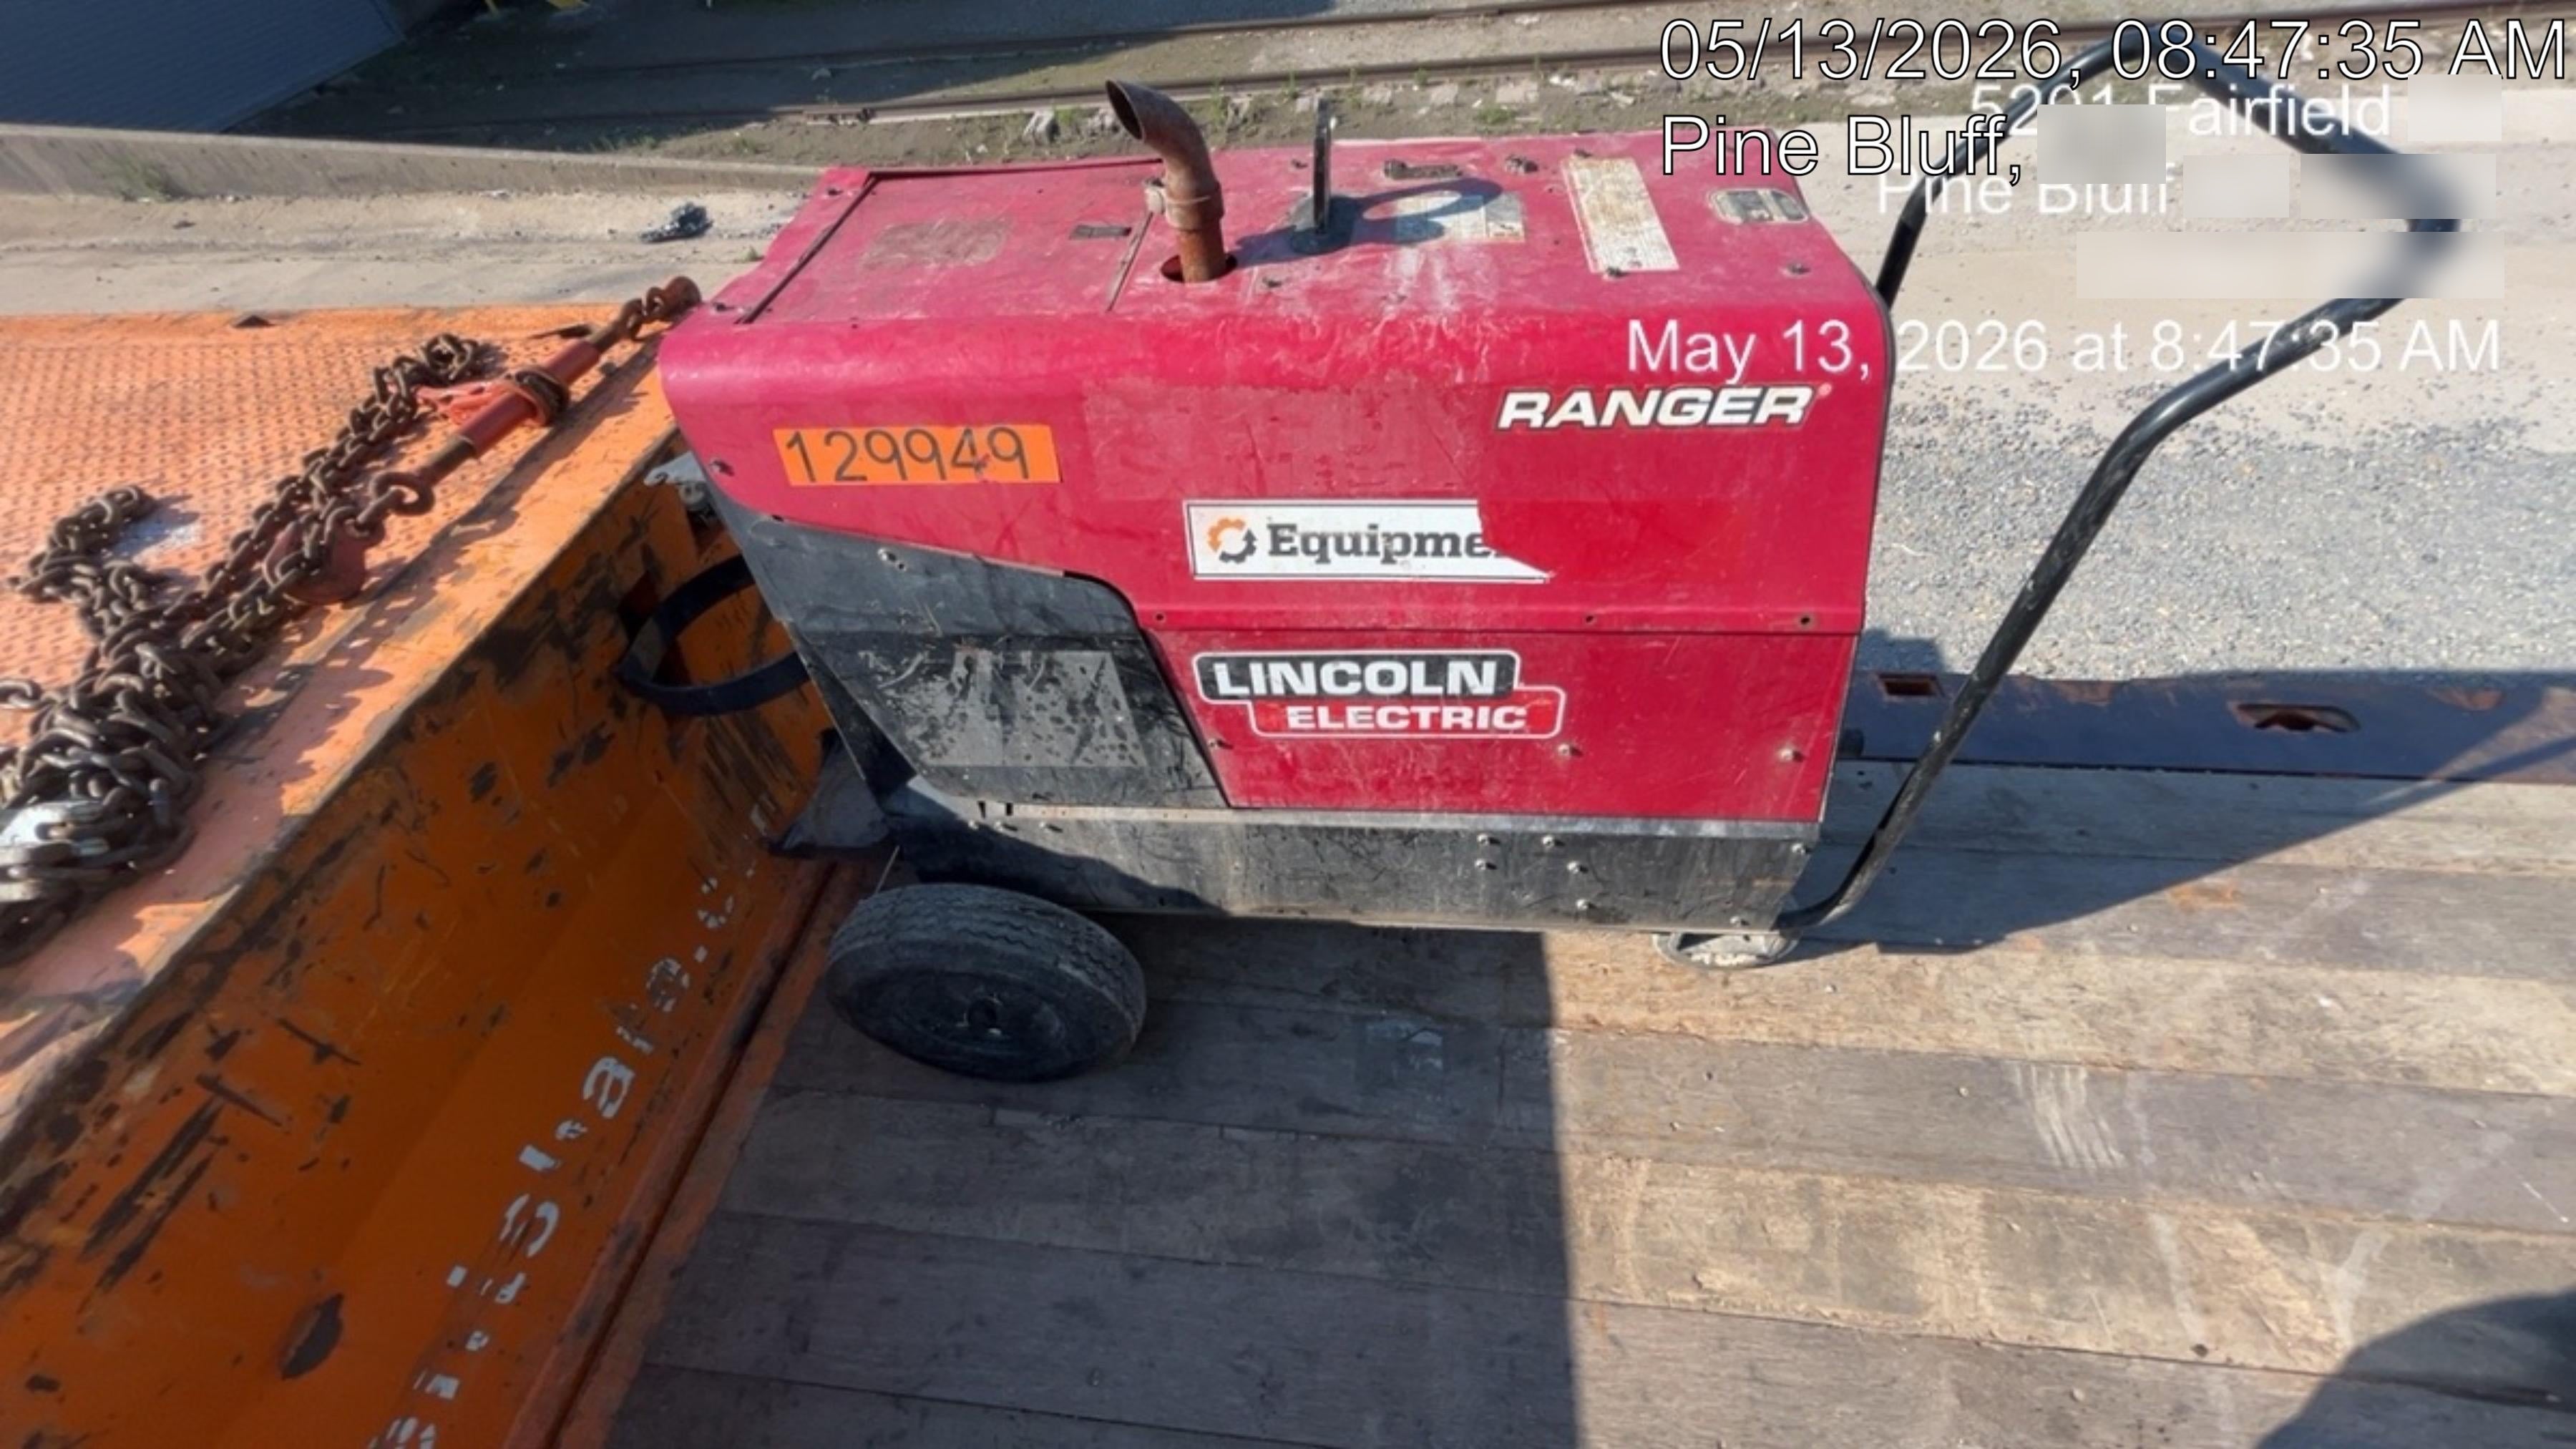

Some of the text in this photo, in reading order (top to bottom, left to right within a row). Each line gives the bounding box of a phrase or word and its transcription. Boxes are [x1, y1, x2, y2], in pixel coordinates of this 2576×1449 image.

[1494, 384, 1815, 431] RANGER
[786, 425, 1030, 484] 129949
[1267, 522, 1503, 565] Equipme
[1213, 660, 1498, 697] LINCOLN
[1286, 705, 1528, 731] ELECTRIC
